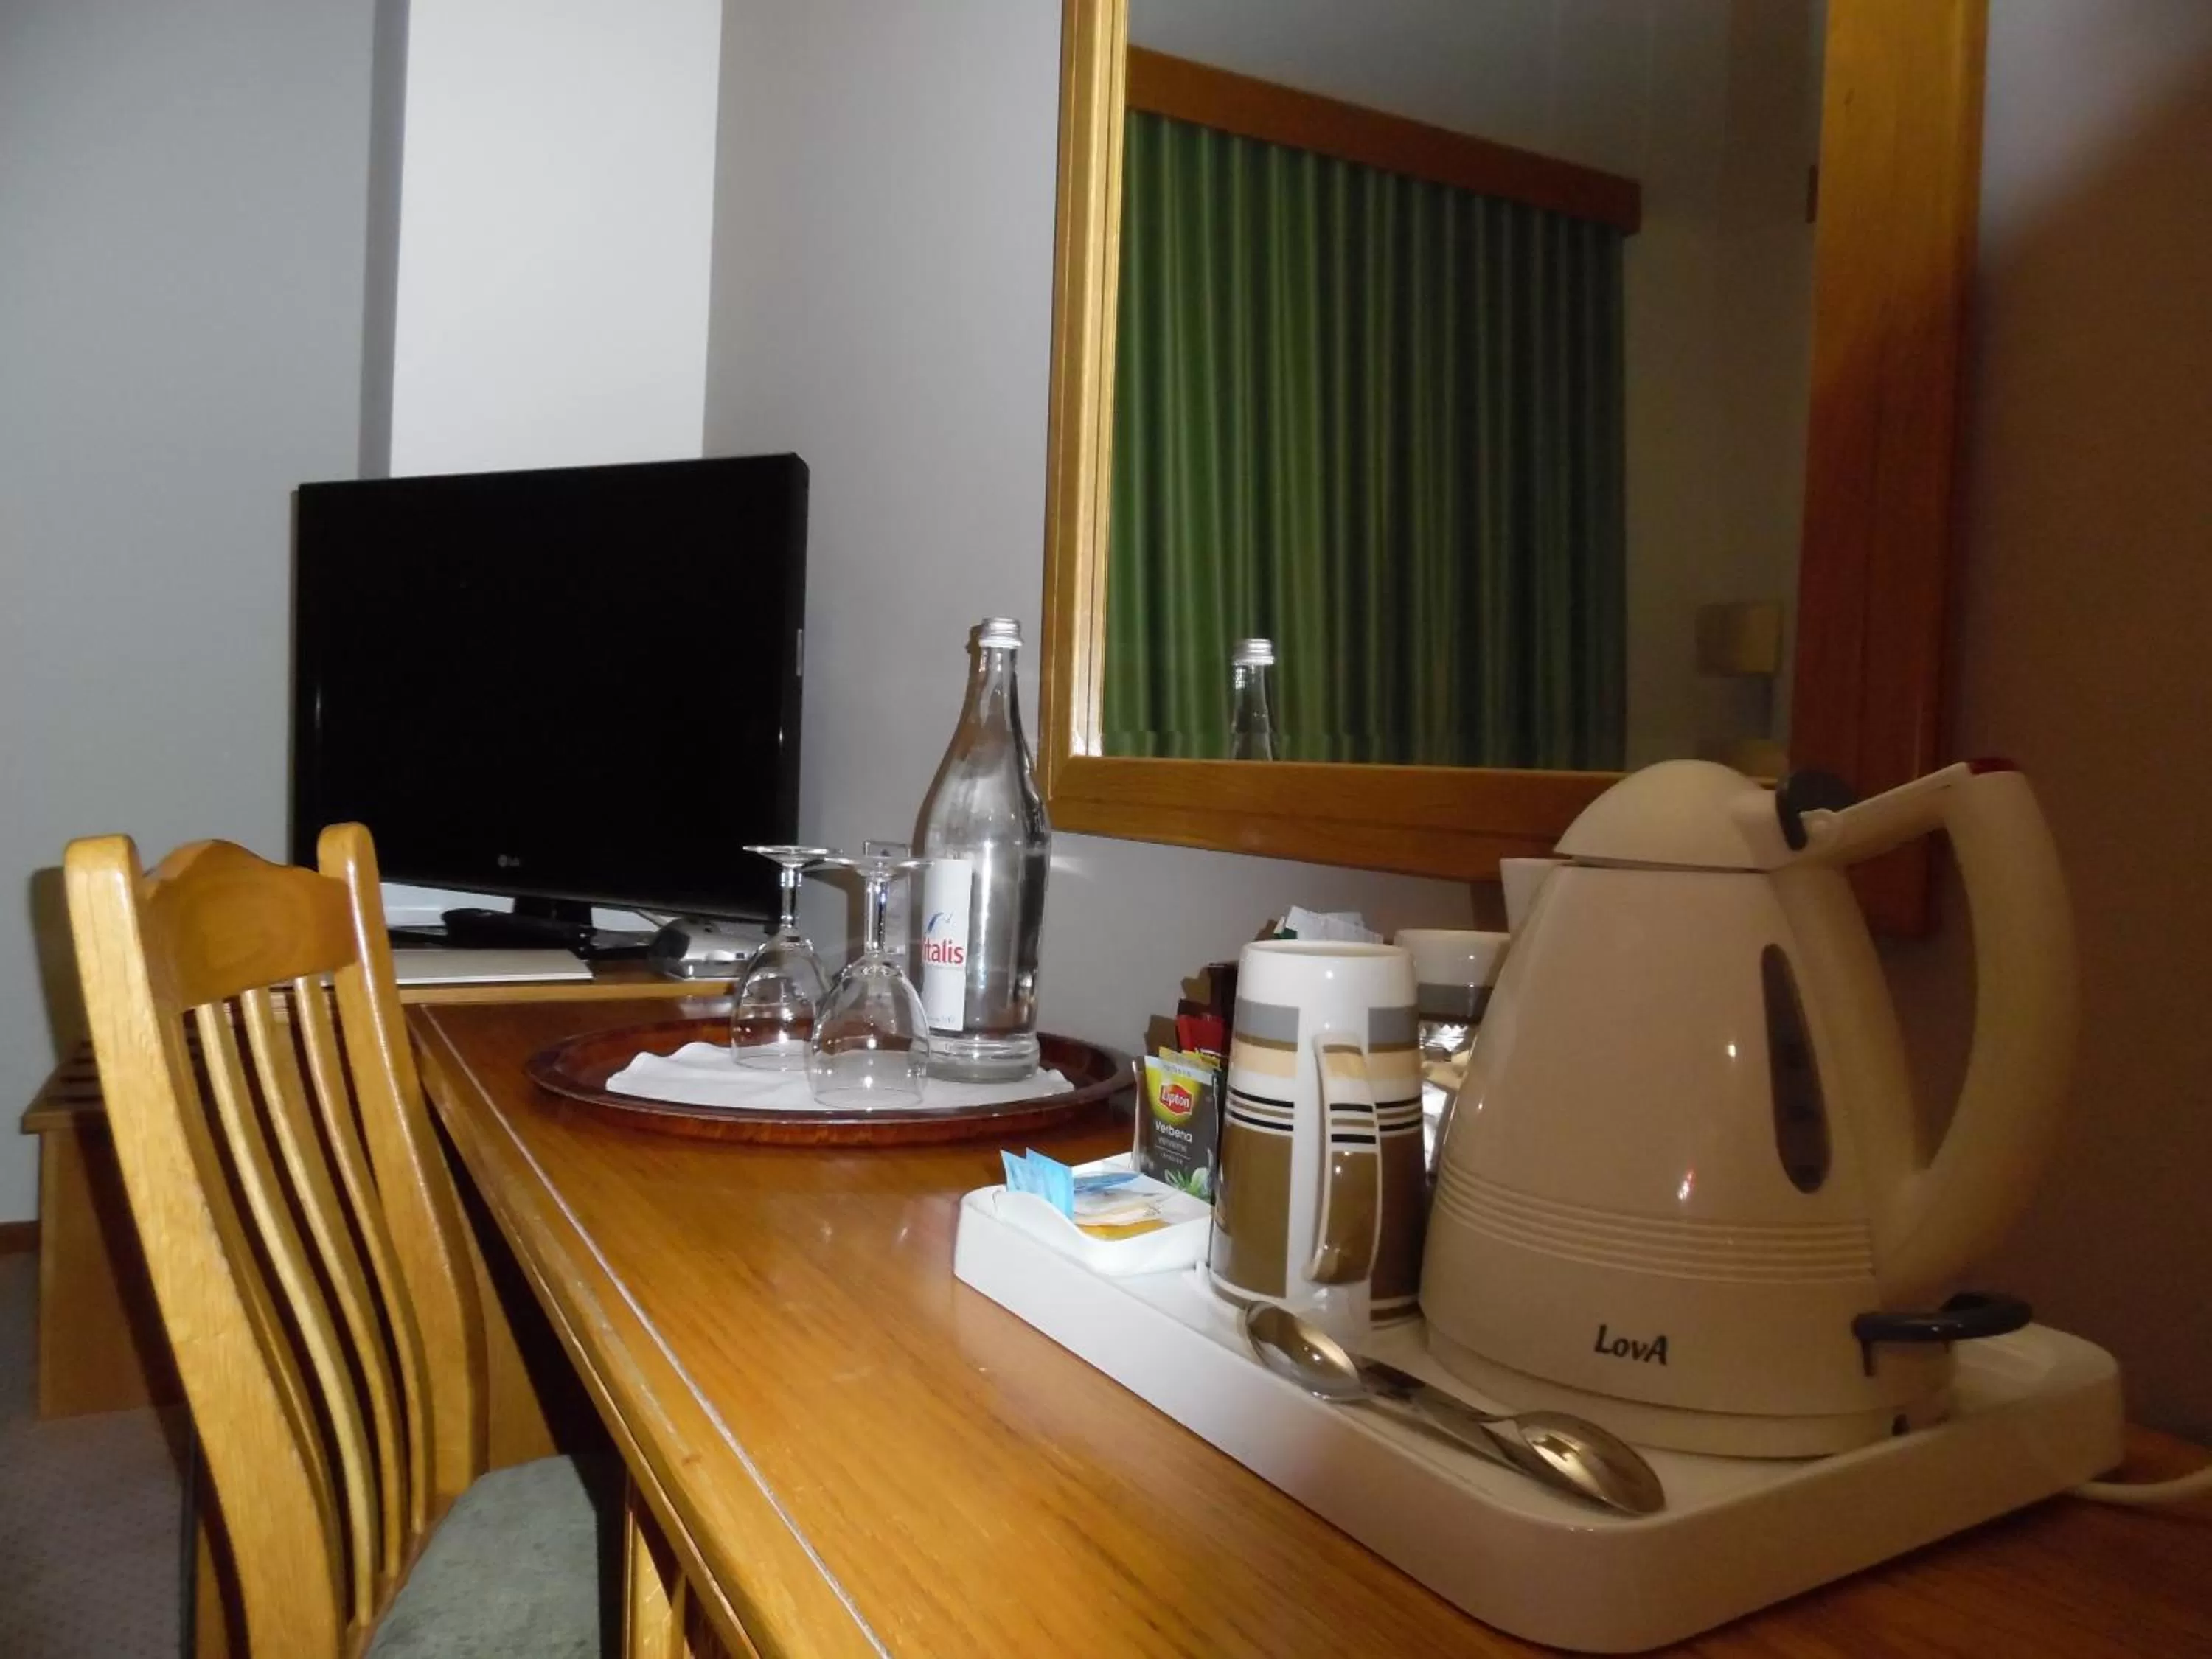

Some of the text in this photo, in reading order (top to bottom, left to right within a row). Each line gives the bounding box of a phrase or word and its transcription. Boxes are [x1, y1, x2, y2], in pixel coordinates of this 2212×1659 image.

[922, 937, 964, 964] italis
[1161, 1088, 1190, 1108] Lipton
[1155, 1121, 1192, 1143] Verbena
